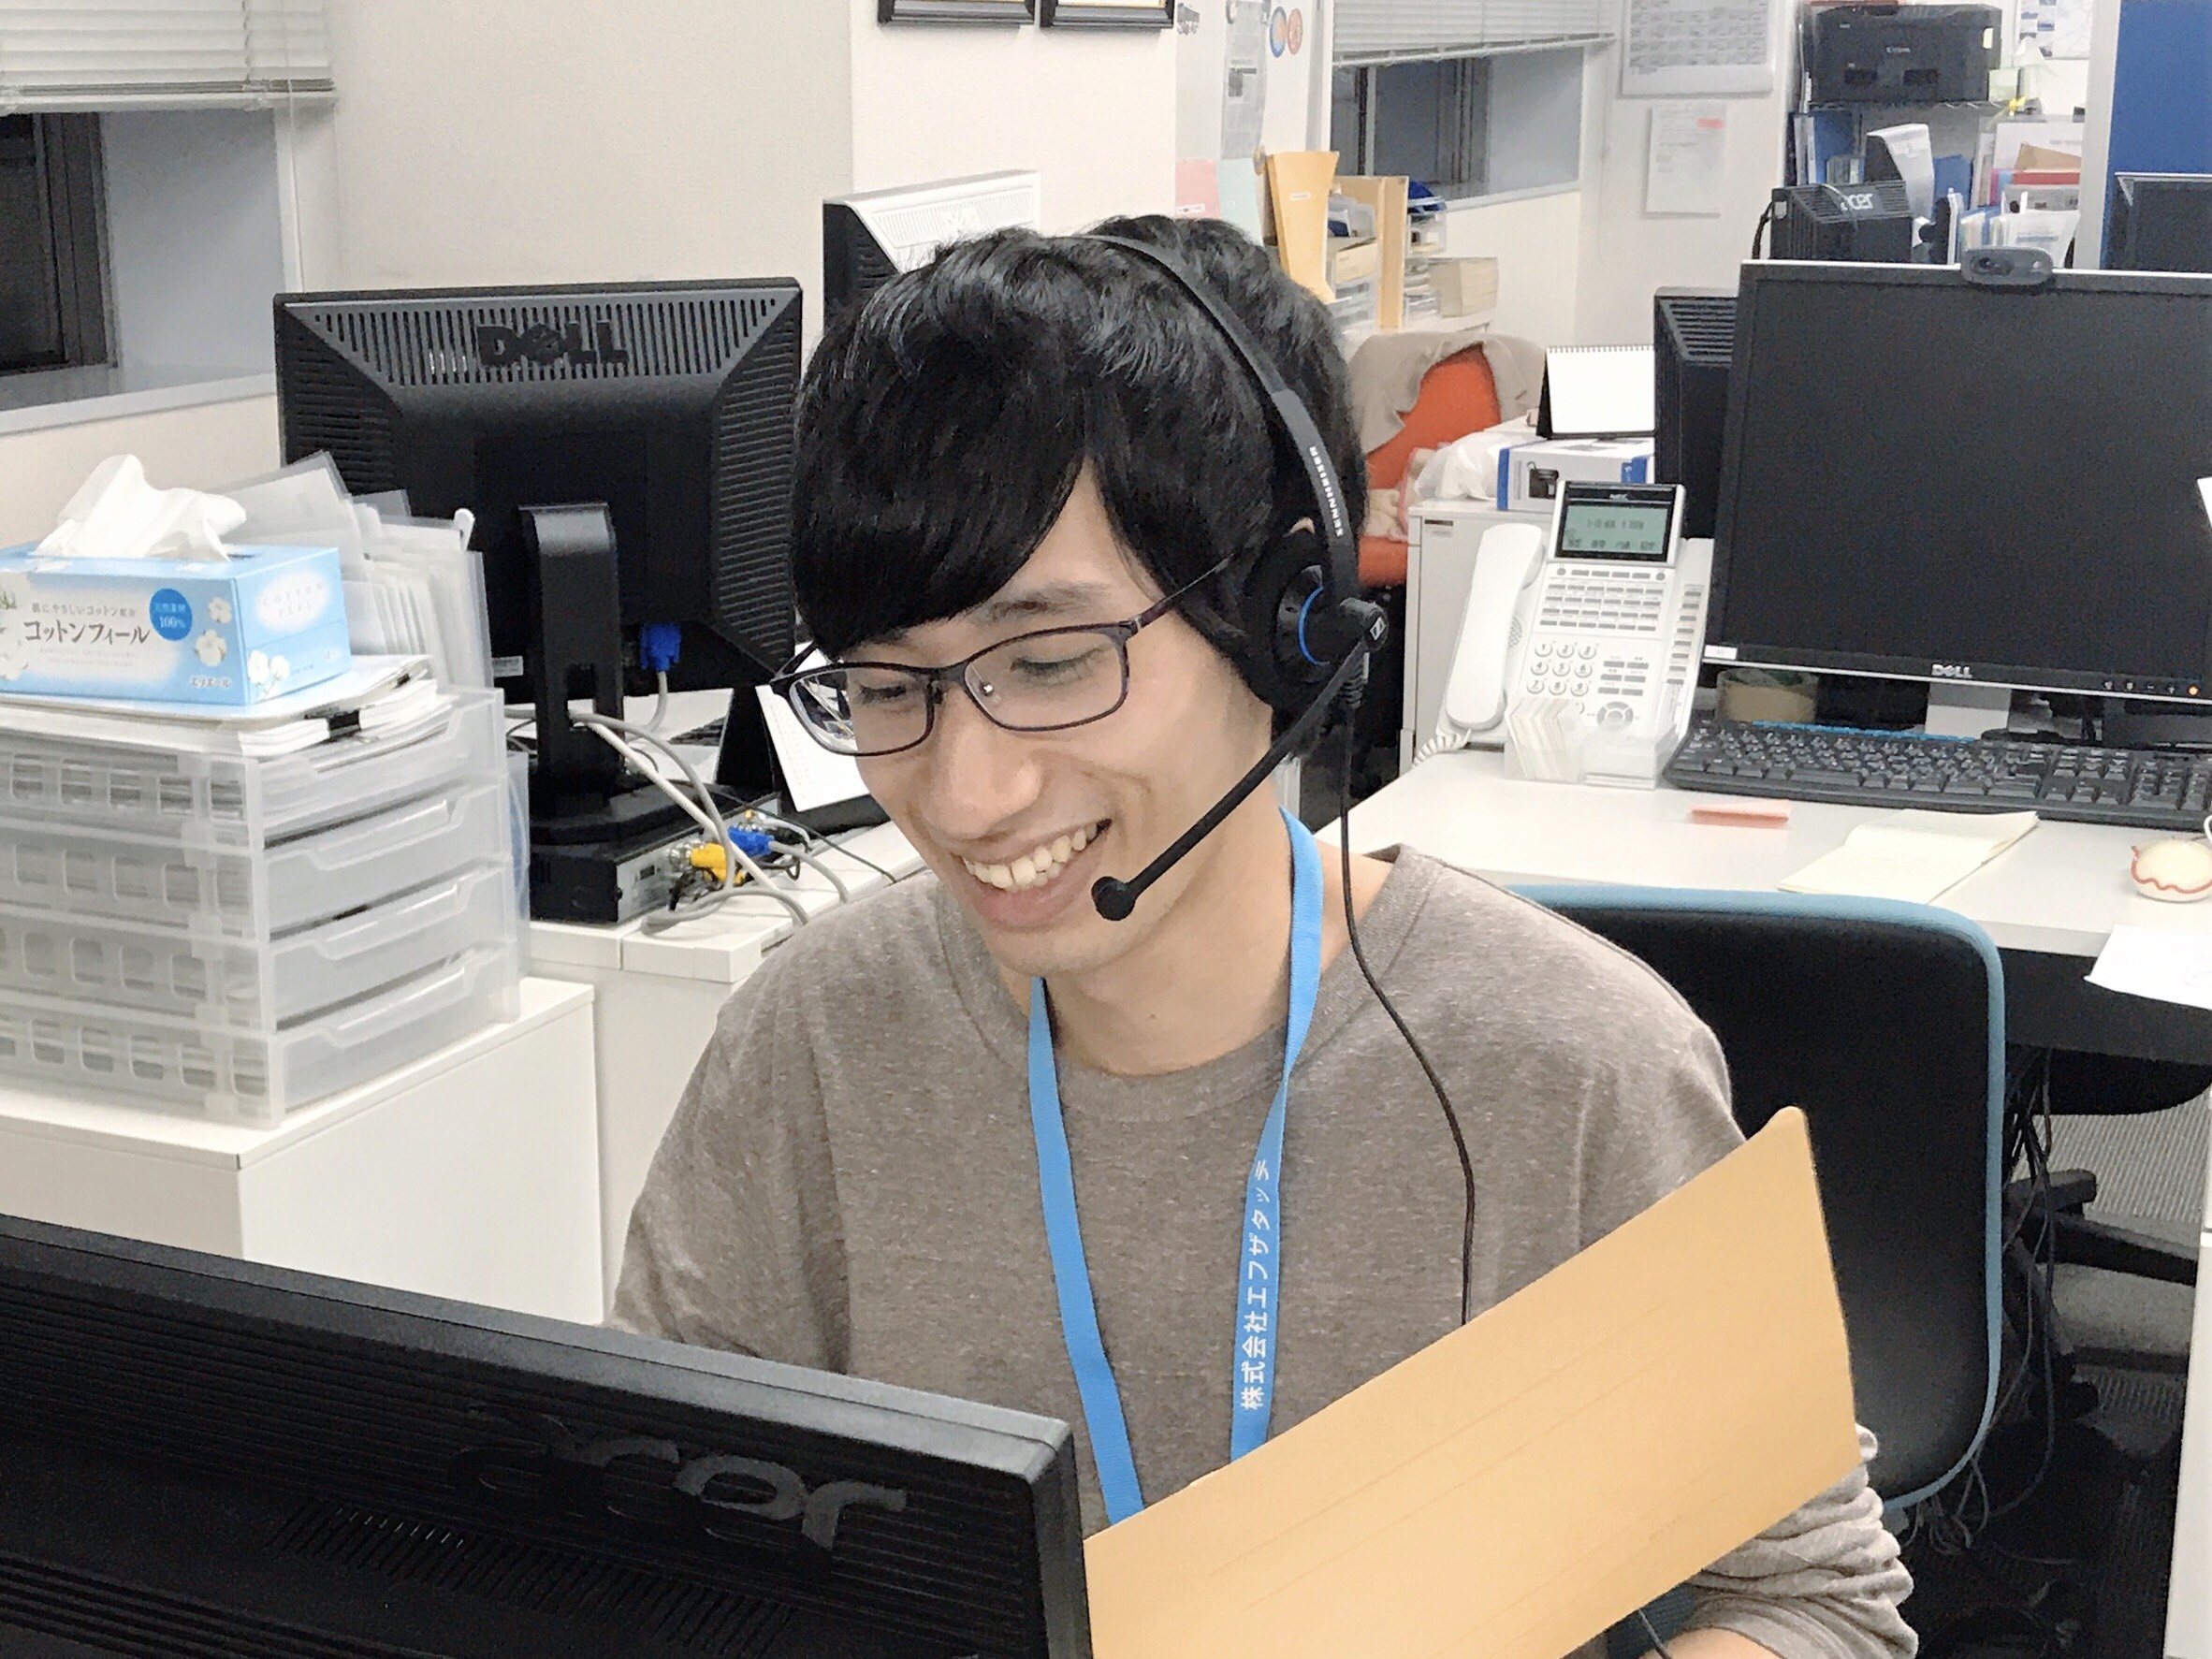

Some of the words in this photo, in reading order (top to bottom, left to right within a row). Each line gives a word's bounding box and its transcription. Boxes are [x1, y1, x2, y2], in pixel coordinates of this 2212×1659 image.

[476, 320, 630, 368] DELL
[23, 618, 151, 646] コットンフィール
[1931, 663, 1972, 679] DELL
[1240, 1158, 1272, 1410] 株式会社エフザタッチ
